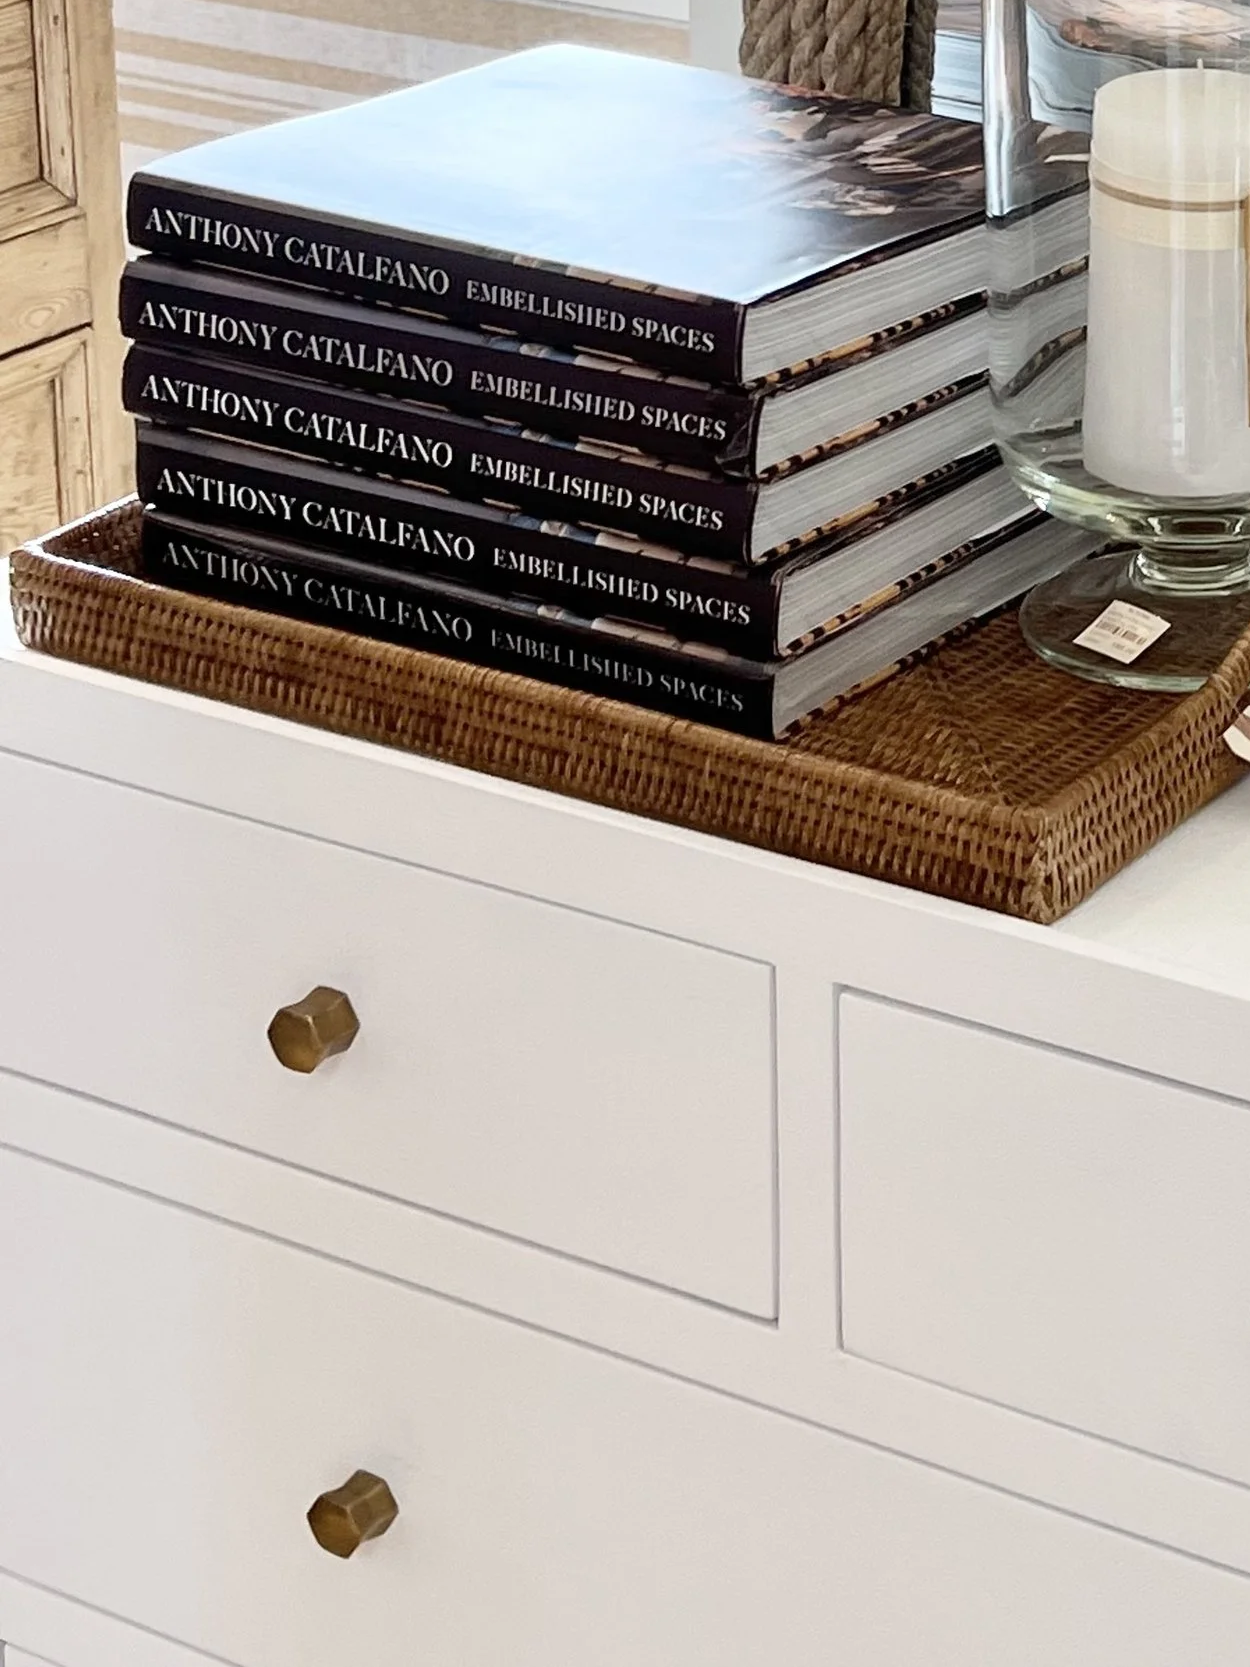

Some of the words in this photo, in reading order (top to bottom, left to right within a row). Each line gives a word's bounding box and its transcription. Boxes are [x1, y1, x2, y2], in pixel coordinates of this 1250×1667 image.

[145, 207, 280, 257] ANTHONY
[284, 236, 450, 296] CATALFANO
[466, 279, 626, 333] EMBELLISHED
[631, 317, 715, 353] SPACES
[138, 301, 278, 351] ANTHONY
[282, 329, 453, 387] CATALFANO
[470, 370, 635, 422] EMBELLISHED
[641, 406, 728, 441] SPACES
[141, 375, 280, 427] ANTHONY
[284, 406, 453, 469] CATALFANO
[470, 453, 633, 509] EMBELLISHED
[638, 494, 724, 531] SPACES
[157, 468, 297, 521] ANTHONY
[302, 501, 475, 562] CATALFANO
[493, 547, 659, 604] EMBELLISHED
[664, 588, 752, 626] SPACES
[163, 542, 298, 598] ANTHONY
[304, 577, 472, 643] CATALFANO
[491, 628, 653, 688] EMBELLISHED
[659, 674, 744, 713] SPACES
